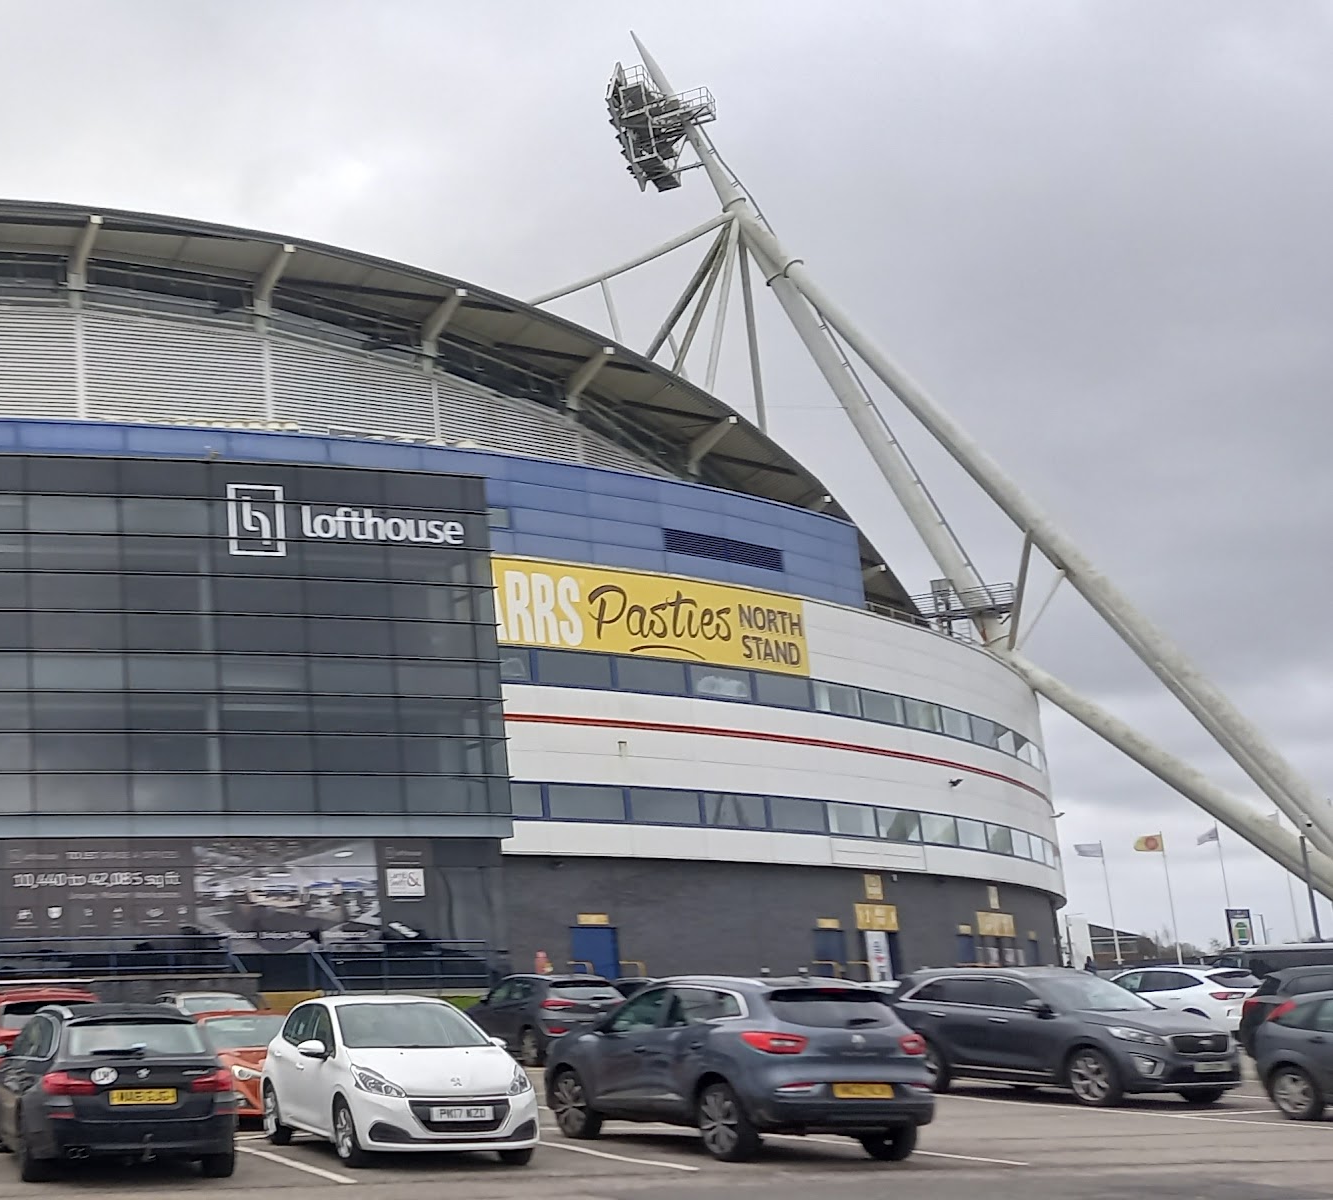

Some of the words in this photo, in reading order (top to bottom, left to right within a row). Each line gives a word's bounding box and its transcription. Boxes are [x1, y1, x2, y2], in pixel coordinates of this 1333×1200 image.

[301, 504, 465, 545] lofthouse
[588, 584, 732, 641] Pasties
[737, 603, 804, 637] NORTH
[742, 635, 802, 666] STAND
[440, 1108, 463, 1119] PK17
